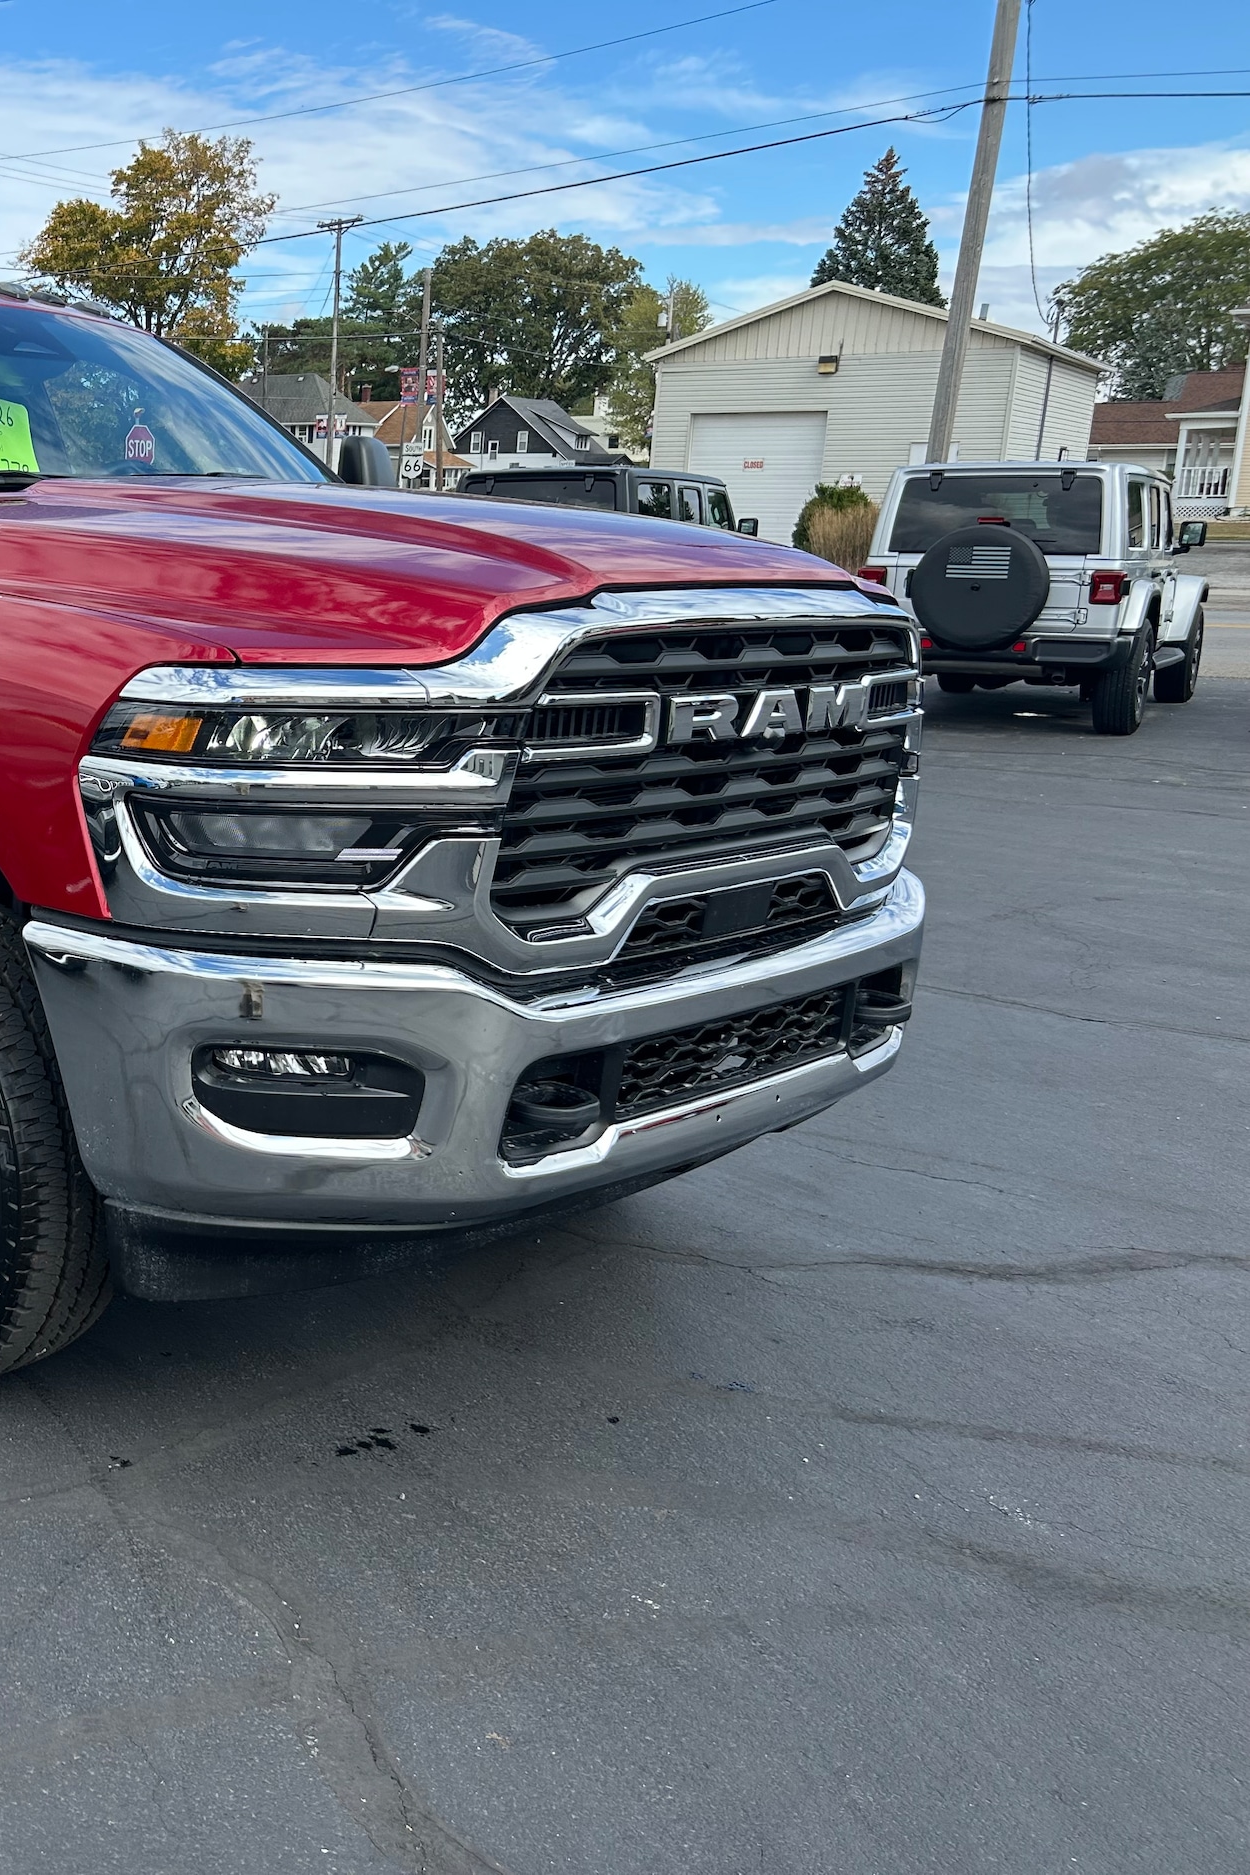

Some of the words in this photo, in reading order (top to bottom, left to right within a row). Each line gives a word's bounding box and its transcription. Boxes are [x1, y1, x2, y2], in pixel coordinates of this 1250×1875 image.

[128, 440, 153, 458] STOP
[405, 444, 423, 453] SOUTH
[404, 459, 421, 472] 66
[743, 460, 764, 469] CLOSED
[667, 684, 864, 745] RAM
